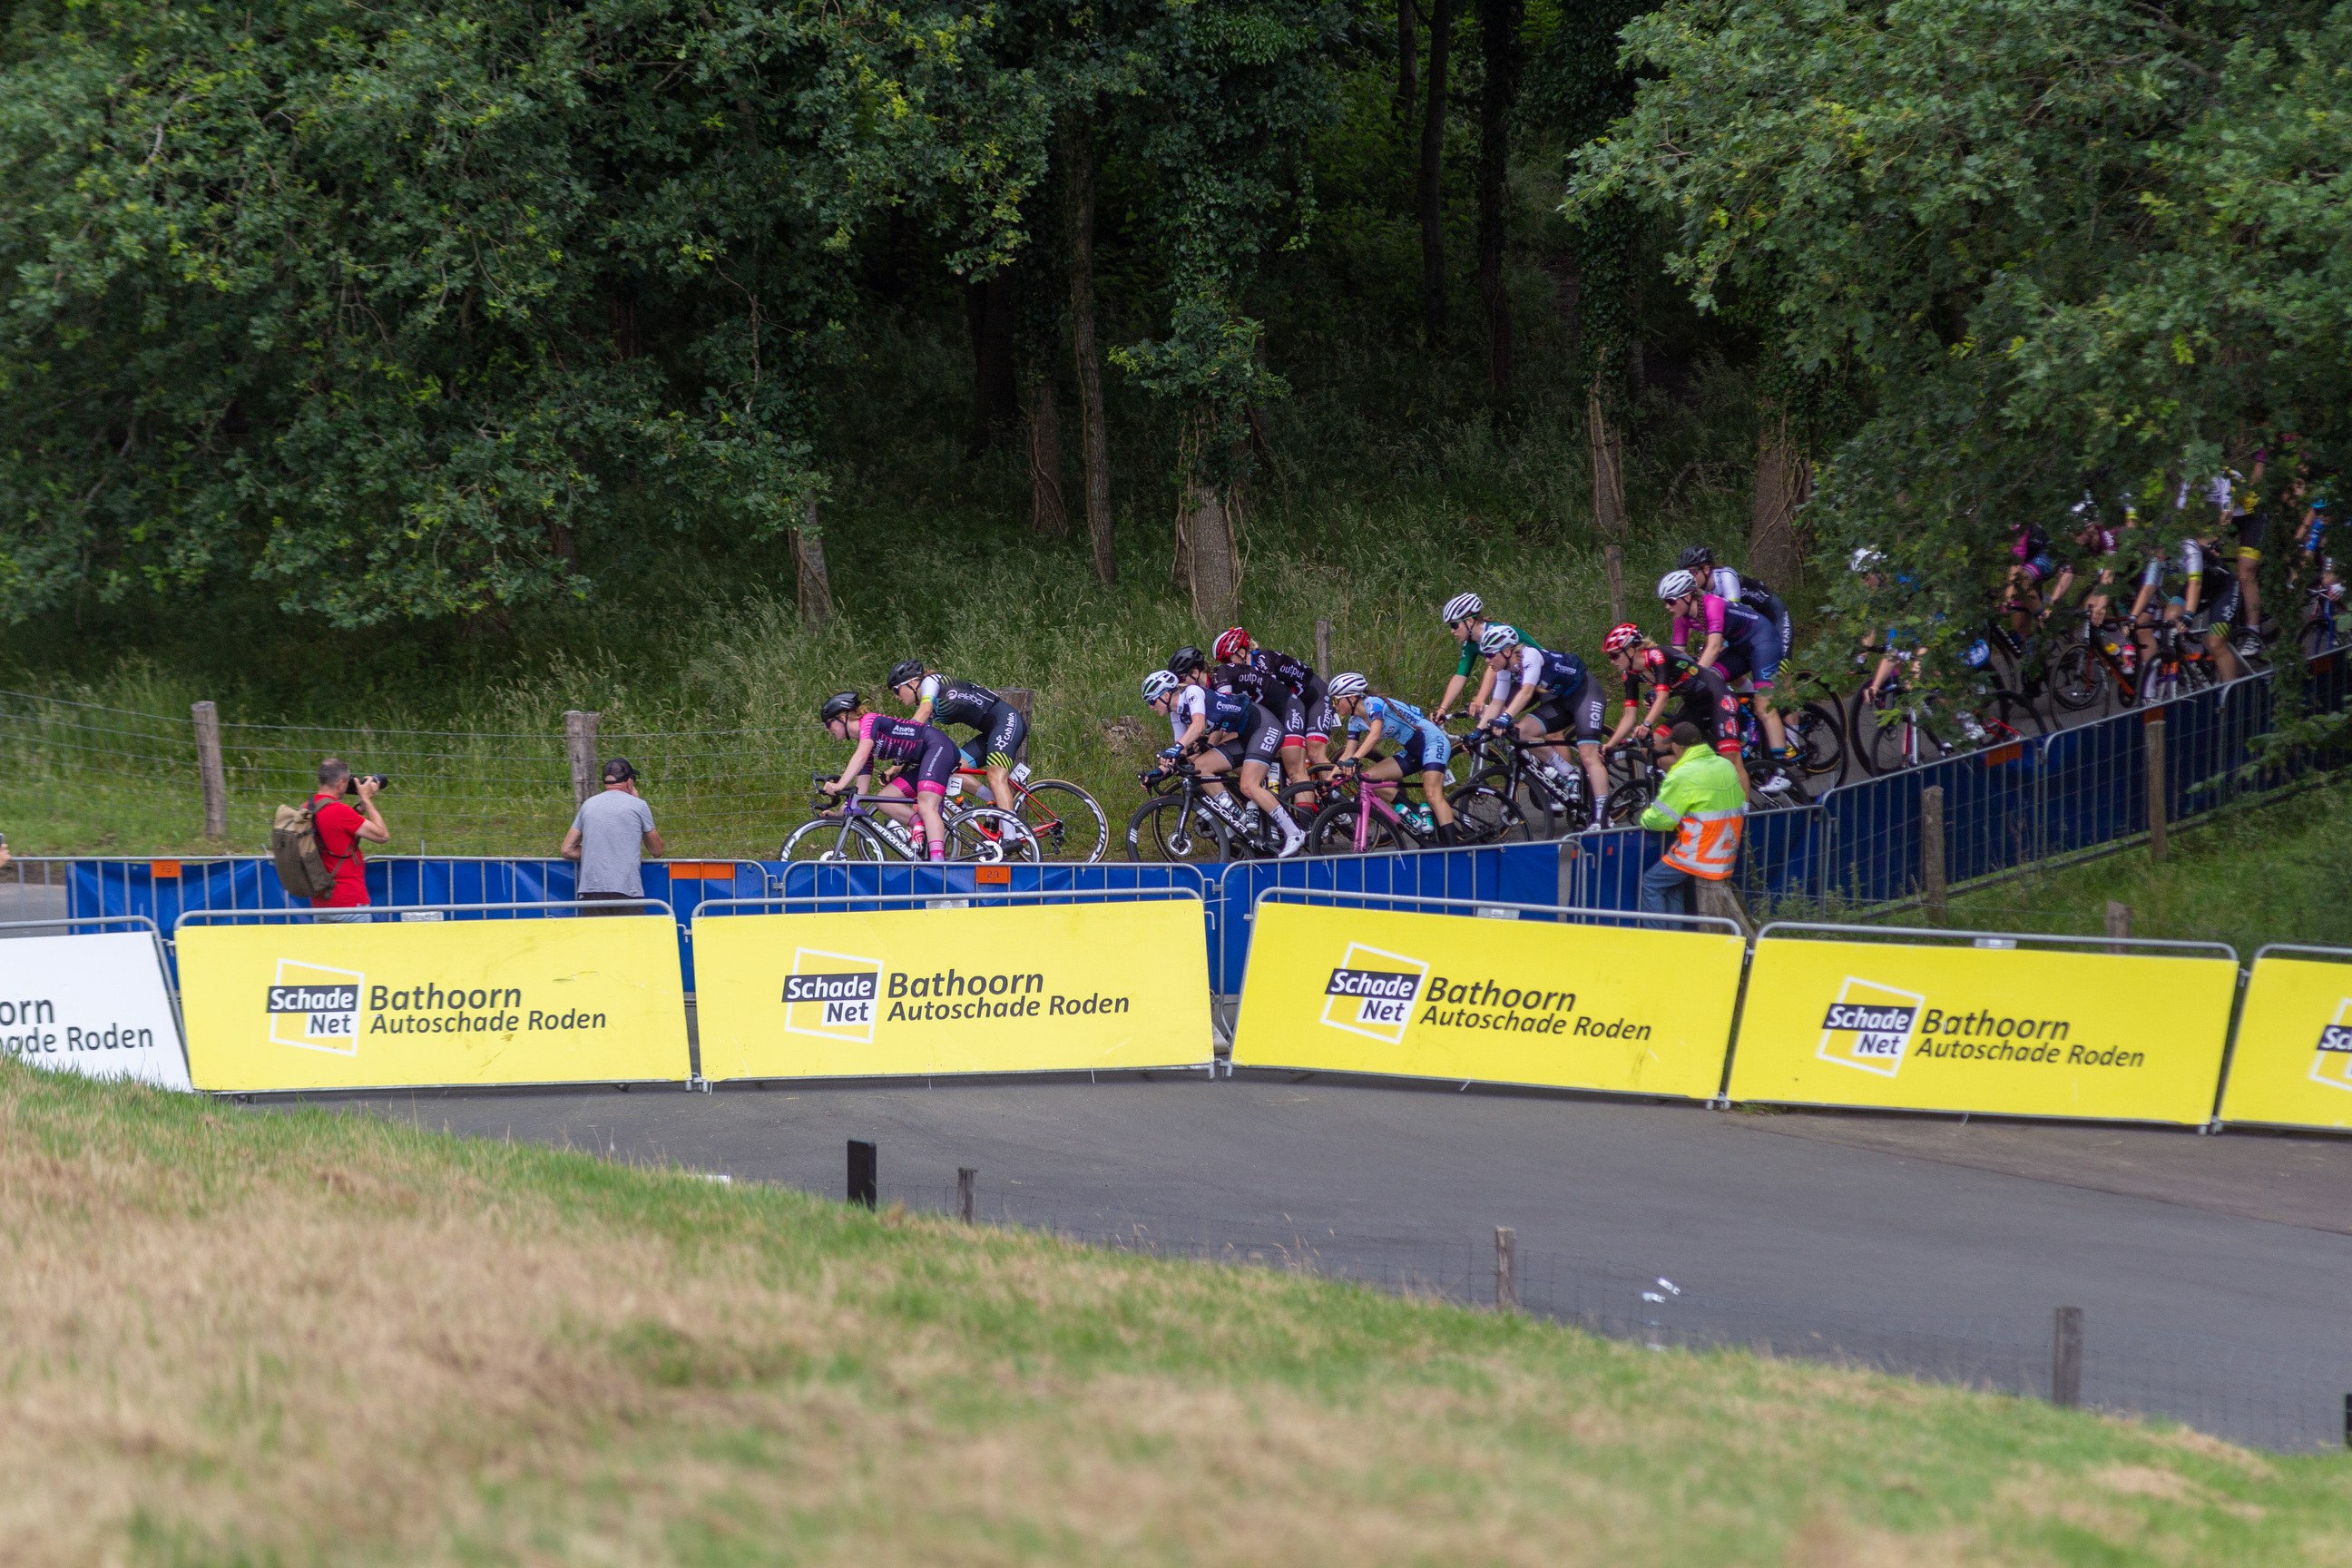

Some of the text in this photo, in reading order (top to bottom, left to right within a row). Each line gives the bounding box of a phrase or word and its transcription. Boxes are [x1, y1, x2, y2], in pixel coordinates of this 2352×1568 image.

[1279, 664, 1305, 681] output
[957, 691, 984, 706] elabo
[1436, 741, 1445, 760] AGU
[1018, 769, 1026, 777] 3
[1269, 765, 1279, 775] 10
[1526, 763, 1569, 801] DOGMA
[950, 780, 961, 789] 17
[1201, 795, 1248, 834] DOGMA
[871, 820, 915, 858] cannondale
[370, 982, 522, 1011] Bathoorn
[786, 975, 873, 999] Schade
[887, 968, 1044, 999] Bathoorn
[1329, 971, 1415, 998] Schade
[1426, 976, 1577, 1013] Bathoorn
[270, 986, 354, 1011] Schade
[887, 993, 1130, 1022] Autoschade Roden
[1361, 1000, 1406, 1023] Net
[309, 1013, 352, 1034] Net
[369, 1007, 607, 1034] Autoschade Roden
[827, 1002, 869, 1023] Net
[1419, 1005, 1651, 1041] Autoschade Roden
[1826, 1004, 1911, 1032] Schade
[1921, 1009, 2071, 1042] Bathoorn
[67, 1022, 153, 1052] Roden
[1857, 1033, 1902, 1056] Net
[1915, 1037, 2145, 1068] Autoschade Roden
